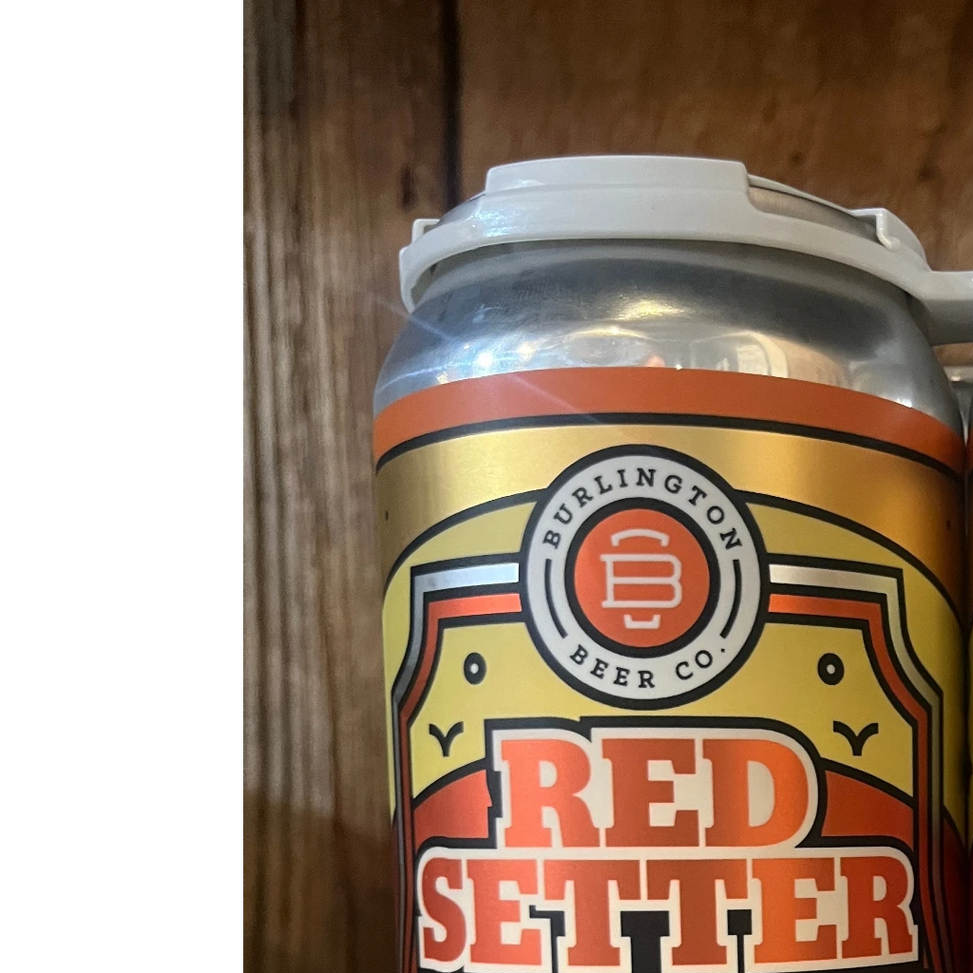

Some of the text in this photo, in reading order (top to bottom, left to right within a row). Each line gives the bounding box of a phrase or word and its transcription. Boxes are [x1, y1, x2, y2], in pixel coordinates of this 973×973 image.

[543, 467, 742, 552] BURLINGTON
[570, 643, 727, 689] BEER CO.
[500, 737, 810, 849] RED
[420, 856, 915, 968] SETTER
